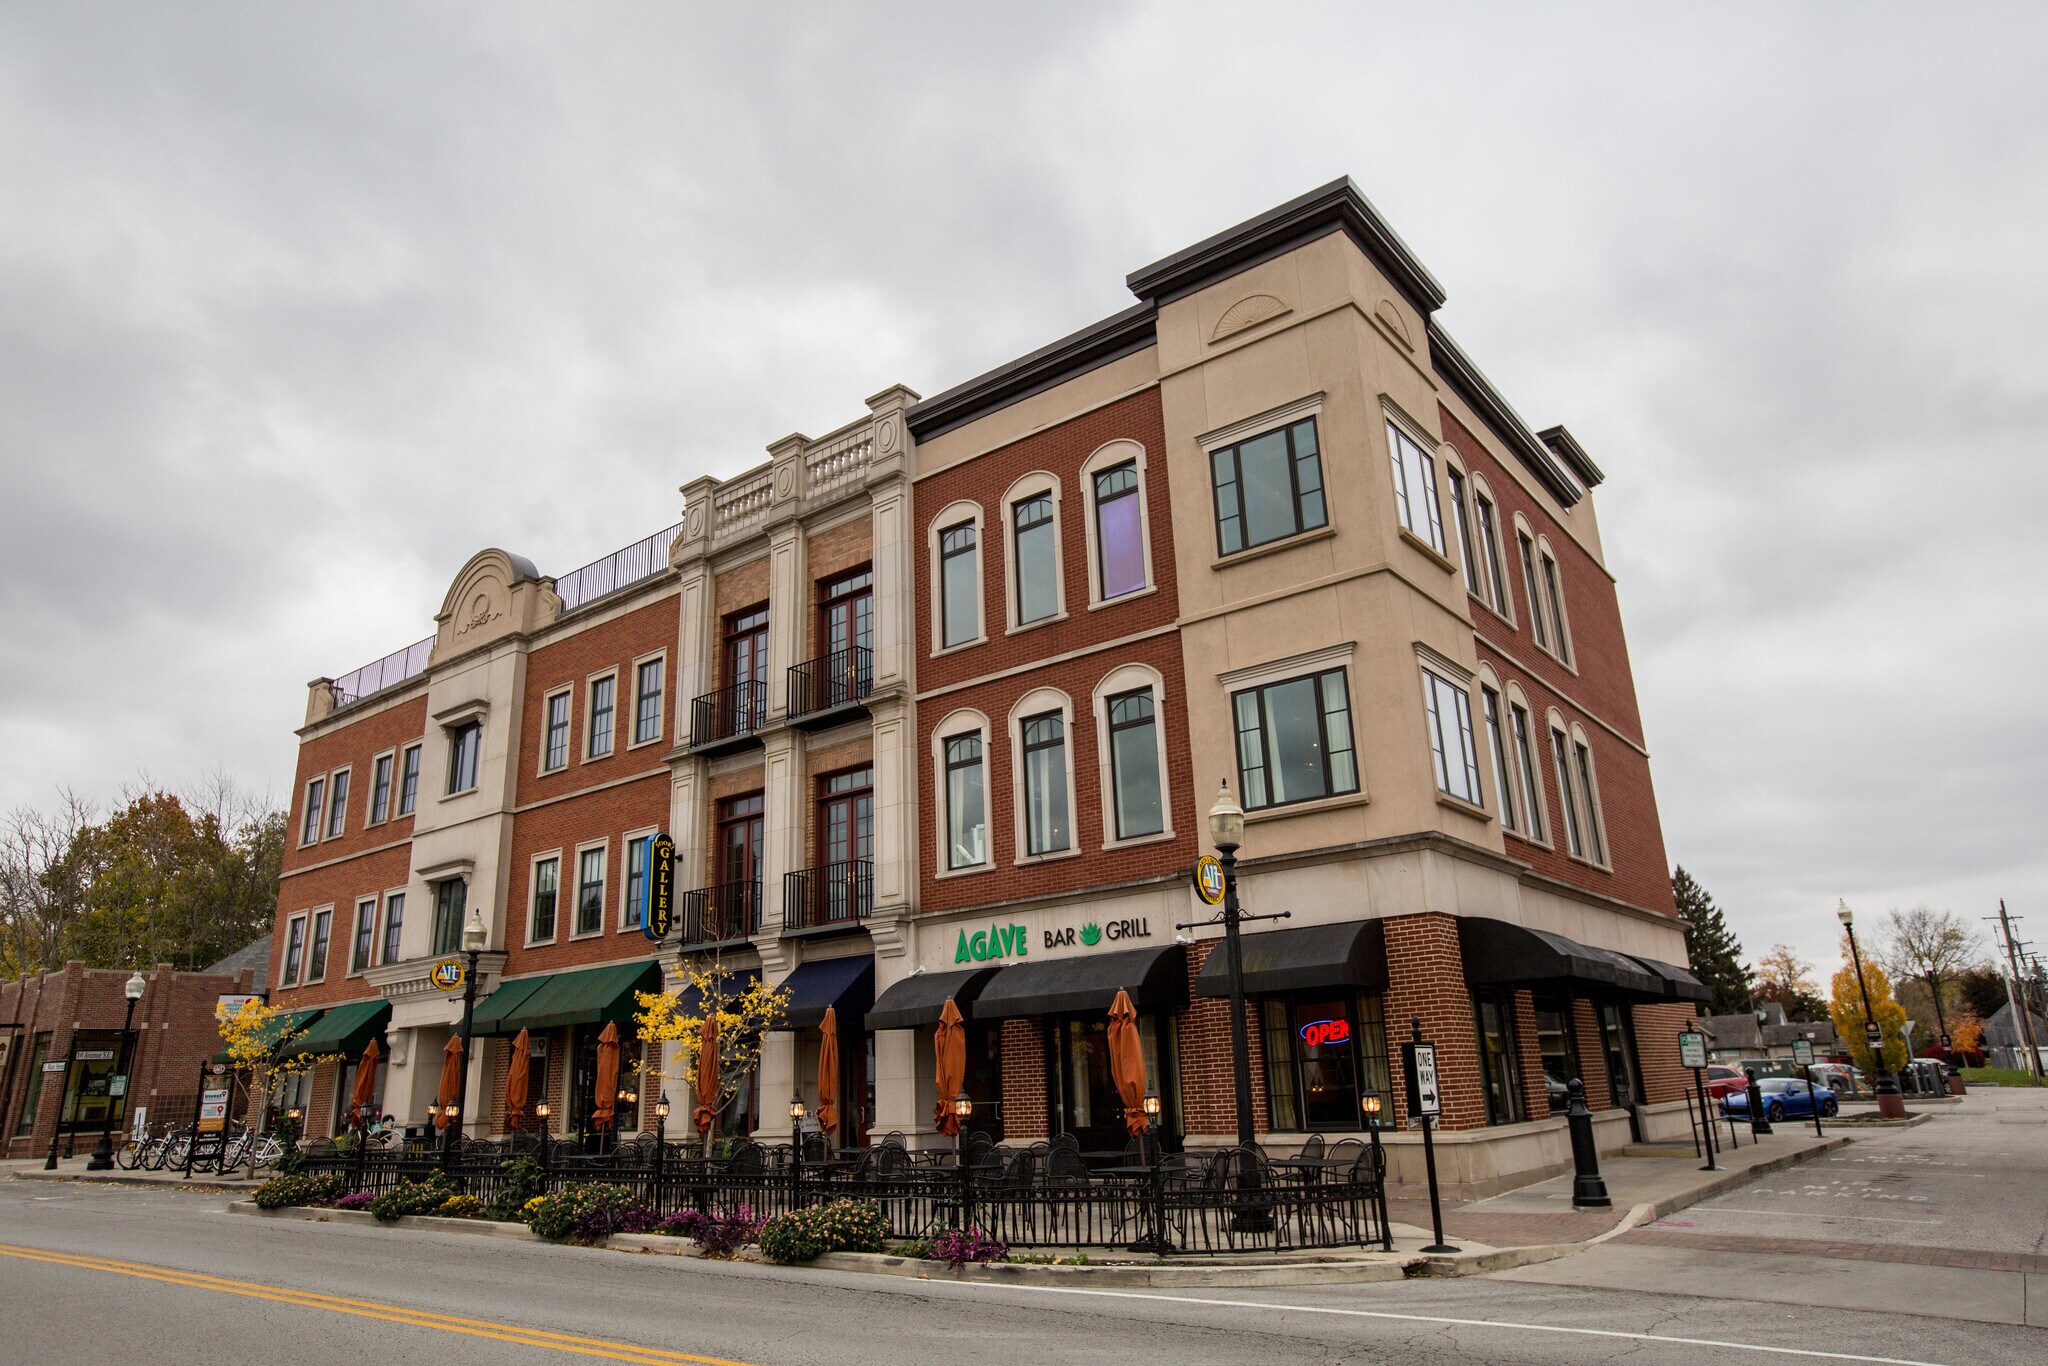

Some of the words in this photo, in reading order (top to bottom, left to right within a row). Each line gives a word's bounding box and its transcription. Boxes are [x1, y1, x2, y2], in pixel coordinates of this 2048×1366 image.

[658, 847, 670, 934] GALLERY
[954, 922, 1028, 963] AGAVE
[1044, 928, 1076, 948] BAR
[1105, 917, 1152, 940] GRILL
[437, 964, 460, 981] Art
[1306, 1019, 1349, 1046] OPEN
[1417, 1051, 1432, 1067] ONE
[1419, 1070, 1434, 1085] WAY
[1752, 1189, 1928, 1201] PARKING
